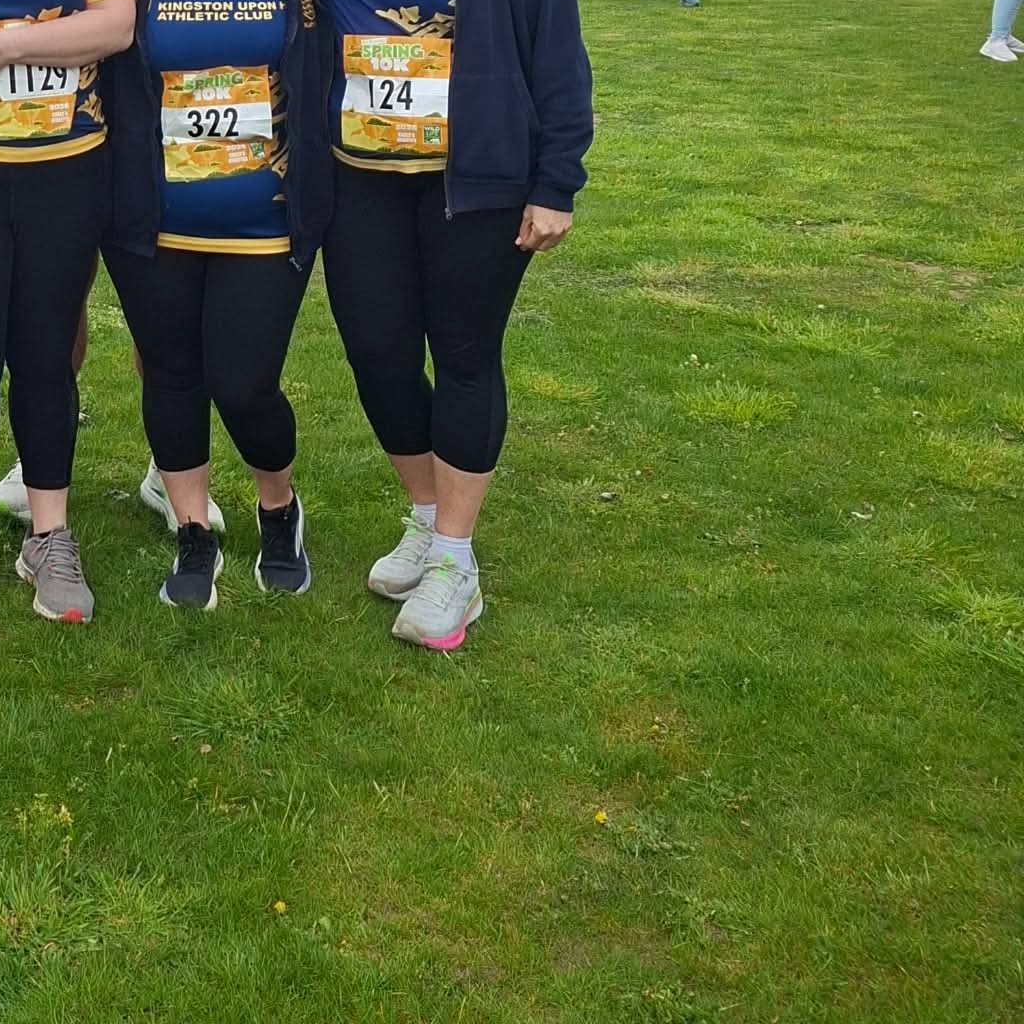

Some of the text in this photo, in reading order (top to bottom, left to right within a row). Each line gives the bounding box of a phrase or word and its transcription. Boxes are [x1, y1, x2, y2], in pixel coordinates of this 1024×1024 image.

[157, 1, 233, 11] KINGSTON
[237, 1, 277, 10] UPON
[157, 10, 273, 21] ATHLETIC CLUB
[362, 44, 424, 58] SPRING
[370, 57, 410, 72] 10K
[9, 63, 68, 94] 1129
[184, 72, 244, 90] SPRING
[192, 87, 232, 101] 10K
[368, 78, 414, 111] 124
[187, 107, 240, 138] 322
